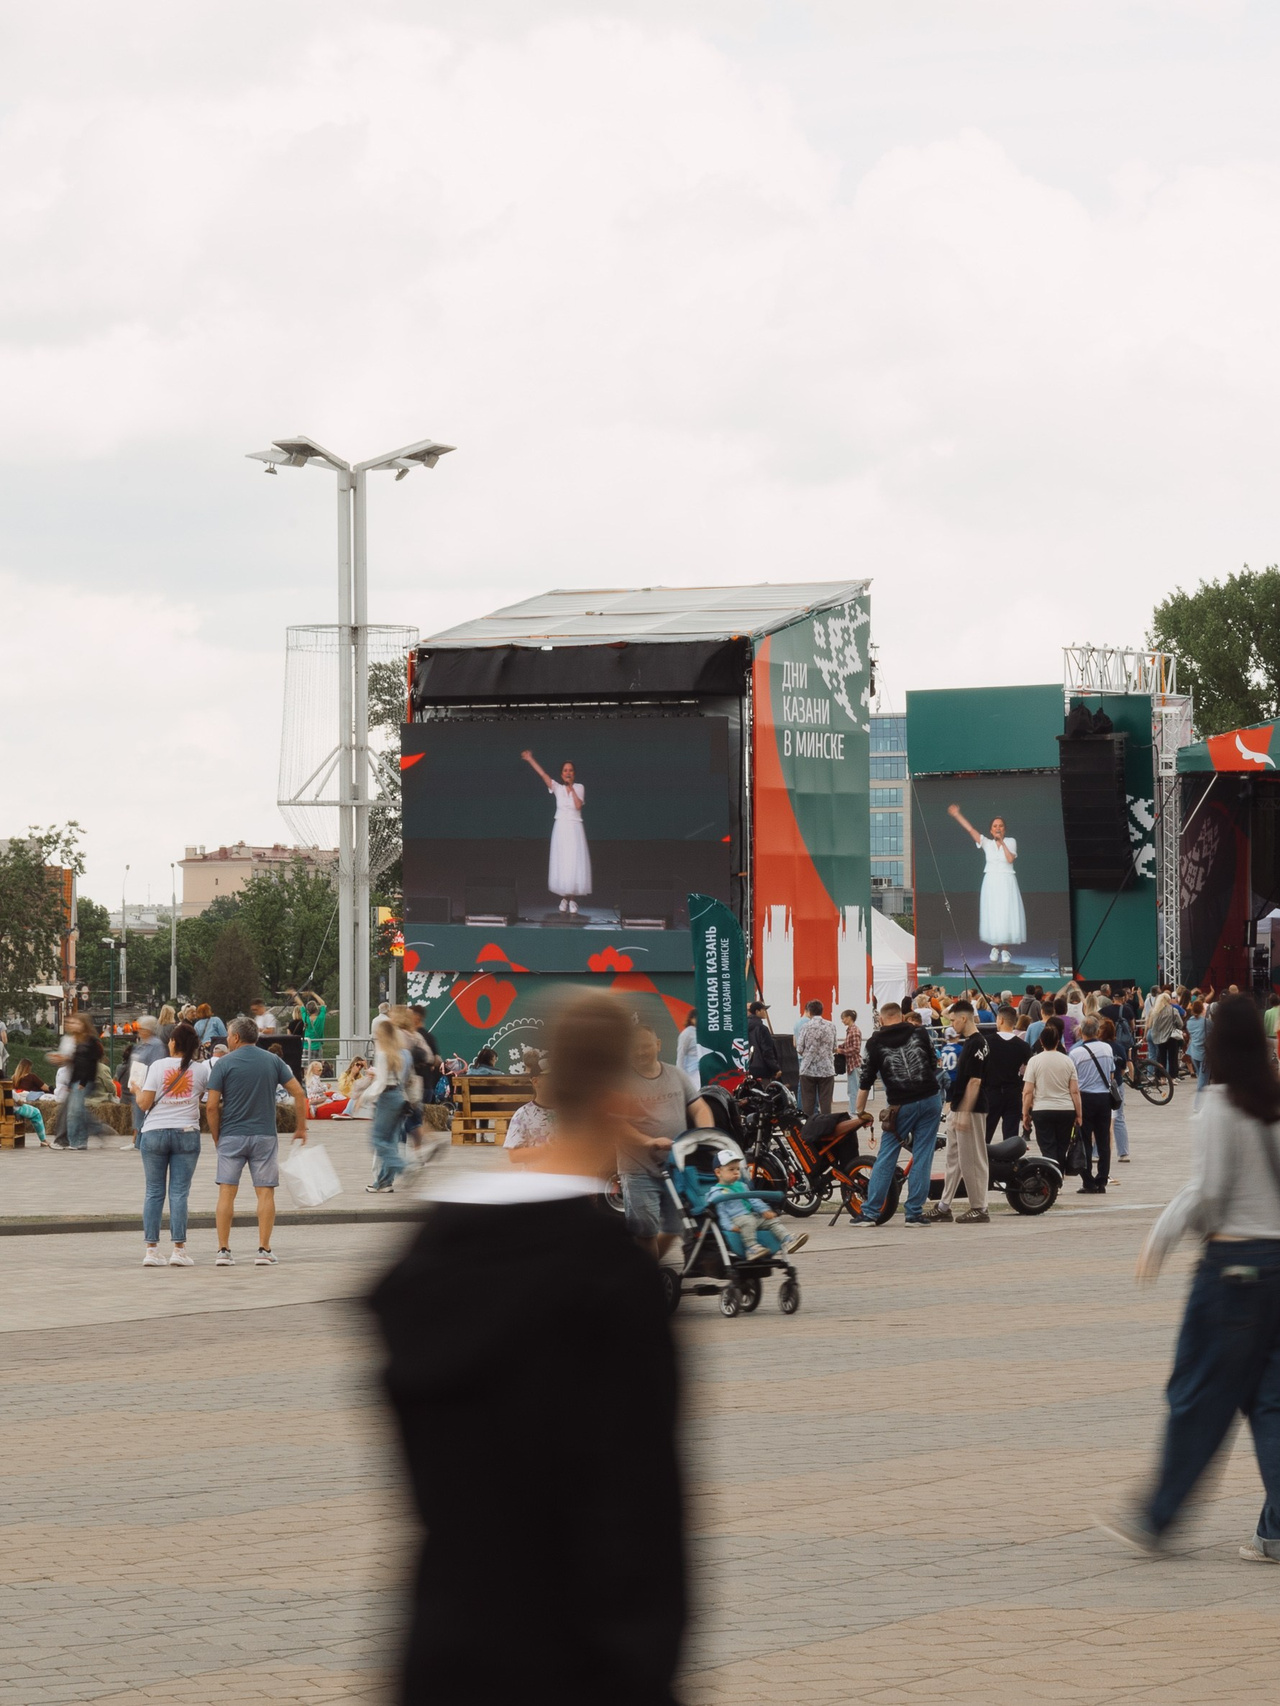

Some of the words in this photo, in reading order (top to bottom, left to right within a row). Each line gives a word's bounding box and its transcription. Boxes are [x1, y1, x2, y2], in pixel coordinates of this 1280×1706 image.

[782, 661, 808, 692] ДНИ
[783, 695, 830, 725] КАЗАНИ
[784, 730, 792, 757] В
[796, 731, 845, 760] МИНСКЕ
[705, 925, 718, 974] КАЗАНЬ
[720, 937, 730, 972] МИНСКЕ
[706, 977, 719, 1032] ВКУСНАЯ
[722, 980, 732, 1013] КАЗАНИ
[723, 1014, 733, 1032] ДНИ
[941, 1051, 957, 1071] 20
